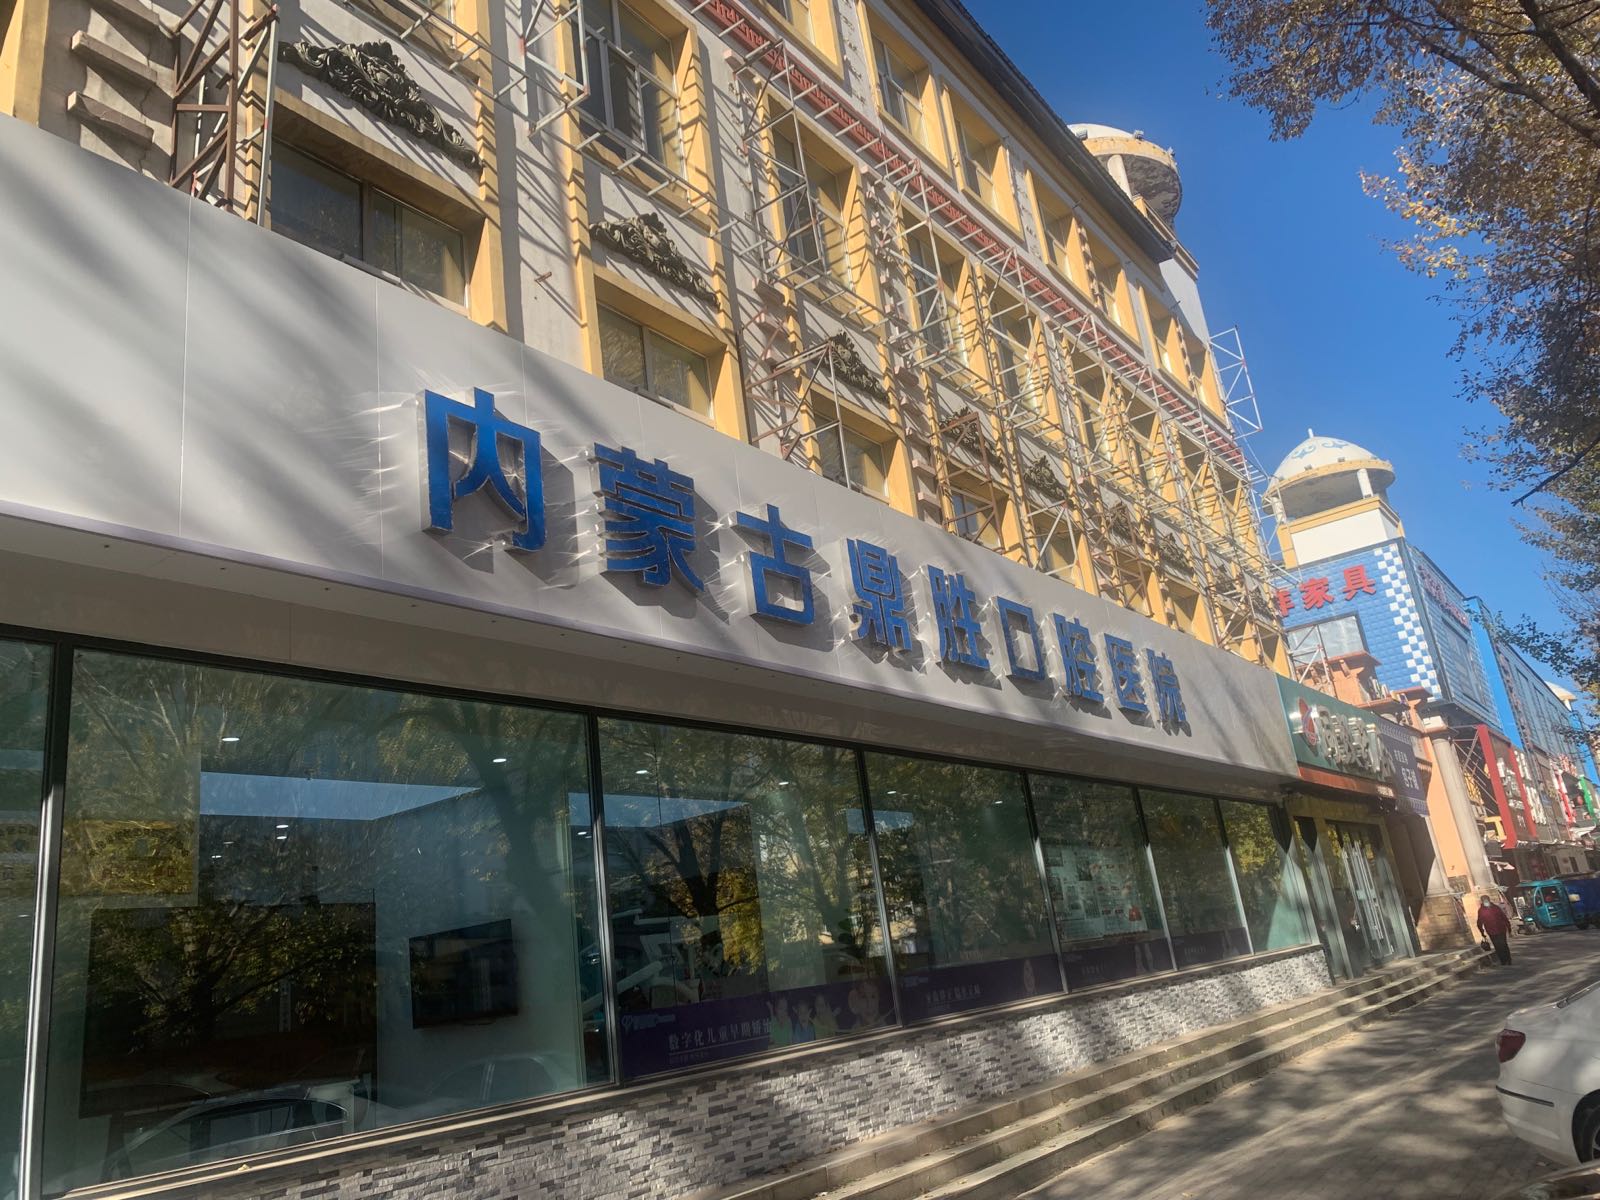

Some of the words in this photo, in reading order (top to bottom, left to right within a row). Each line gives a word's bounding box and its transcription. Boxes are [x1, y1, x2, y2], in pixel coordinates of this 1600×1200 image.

[424, 387, 1187, 734] 内蒙古鼎胜口腔医院
